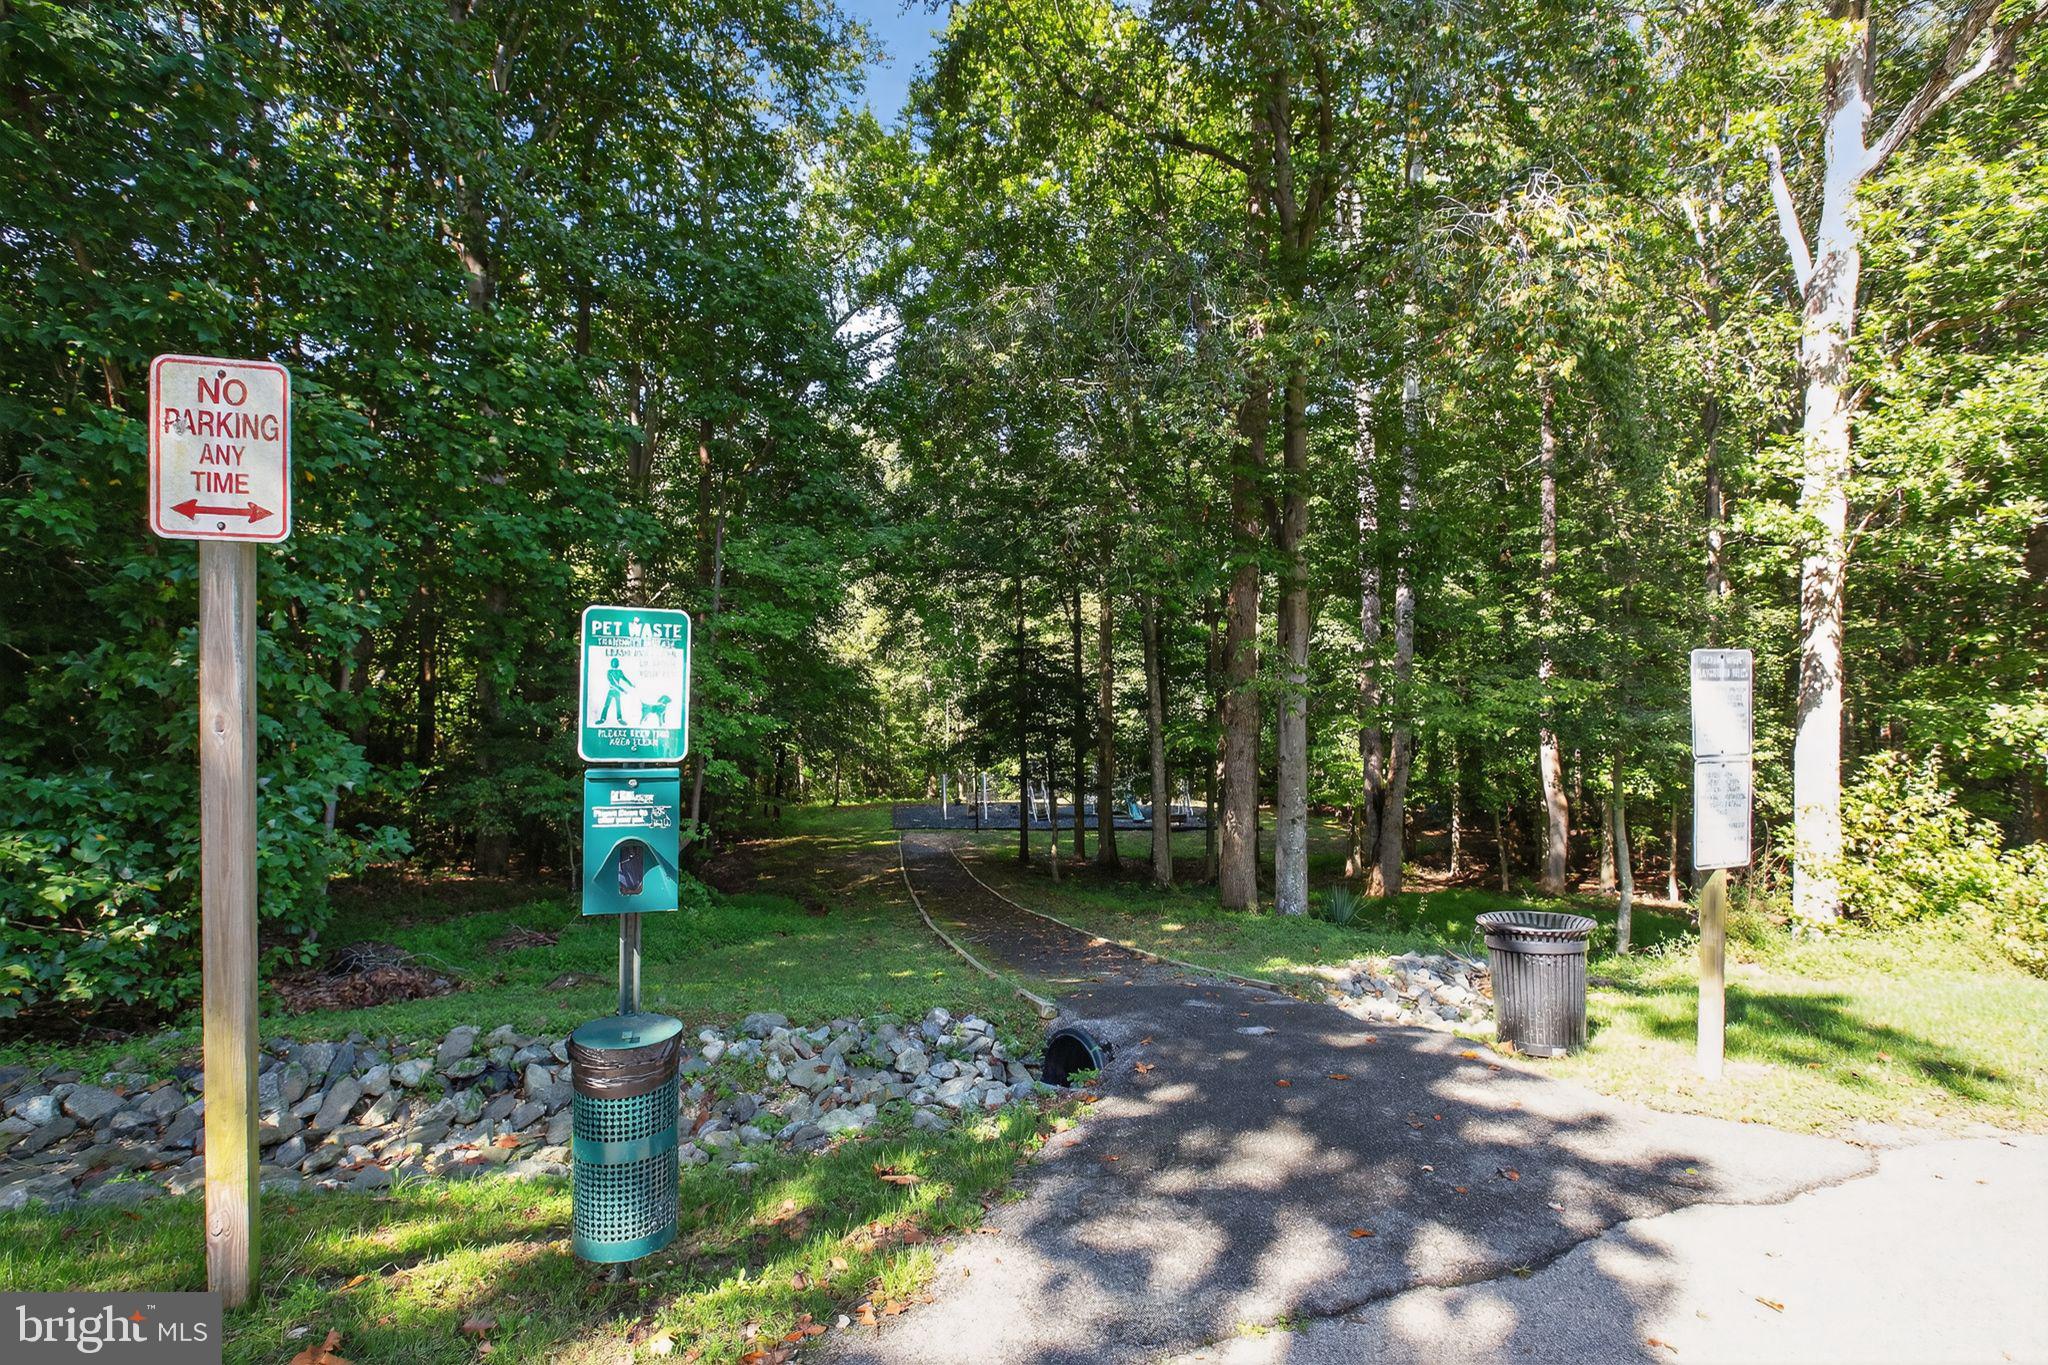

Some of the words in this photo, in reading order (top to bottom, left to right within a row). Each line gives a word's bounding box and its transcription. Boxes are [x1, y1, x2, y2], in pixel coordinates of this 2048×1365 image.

[197, 376, 248, 407] NO
[163, 407, 279, 442] PARKING
[198, 443, 246, 466] ANY
[190, 471, 250, 495] TIME
[591, 620, 623, 636] PET
[628, 621, 682, 639] WASTE
